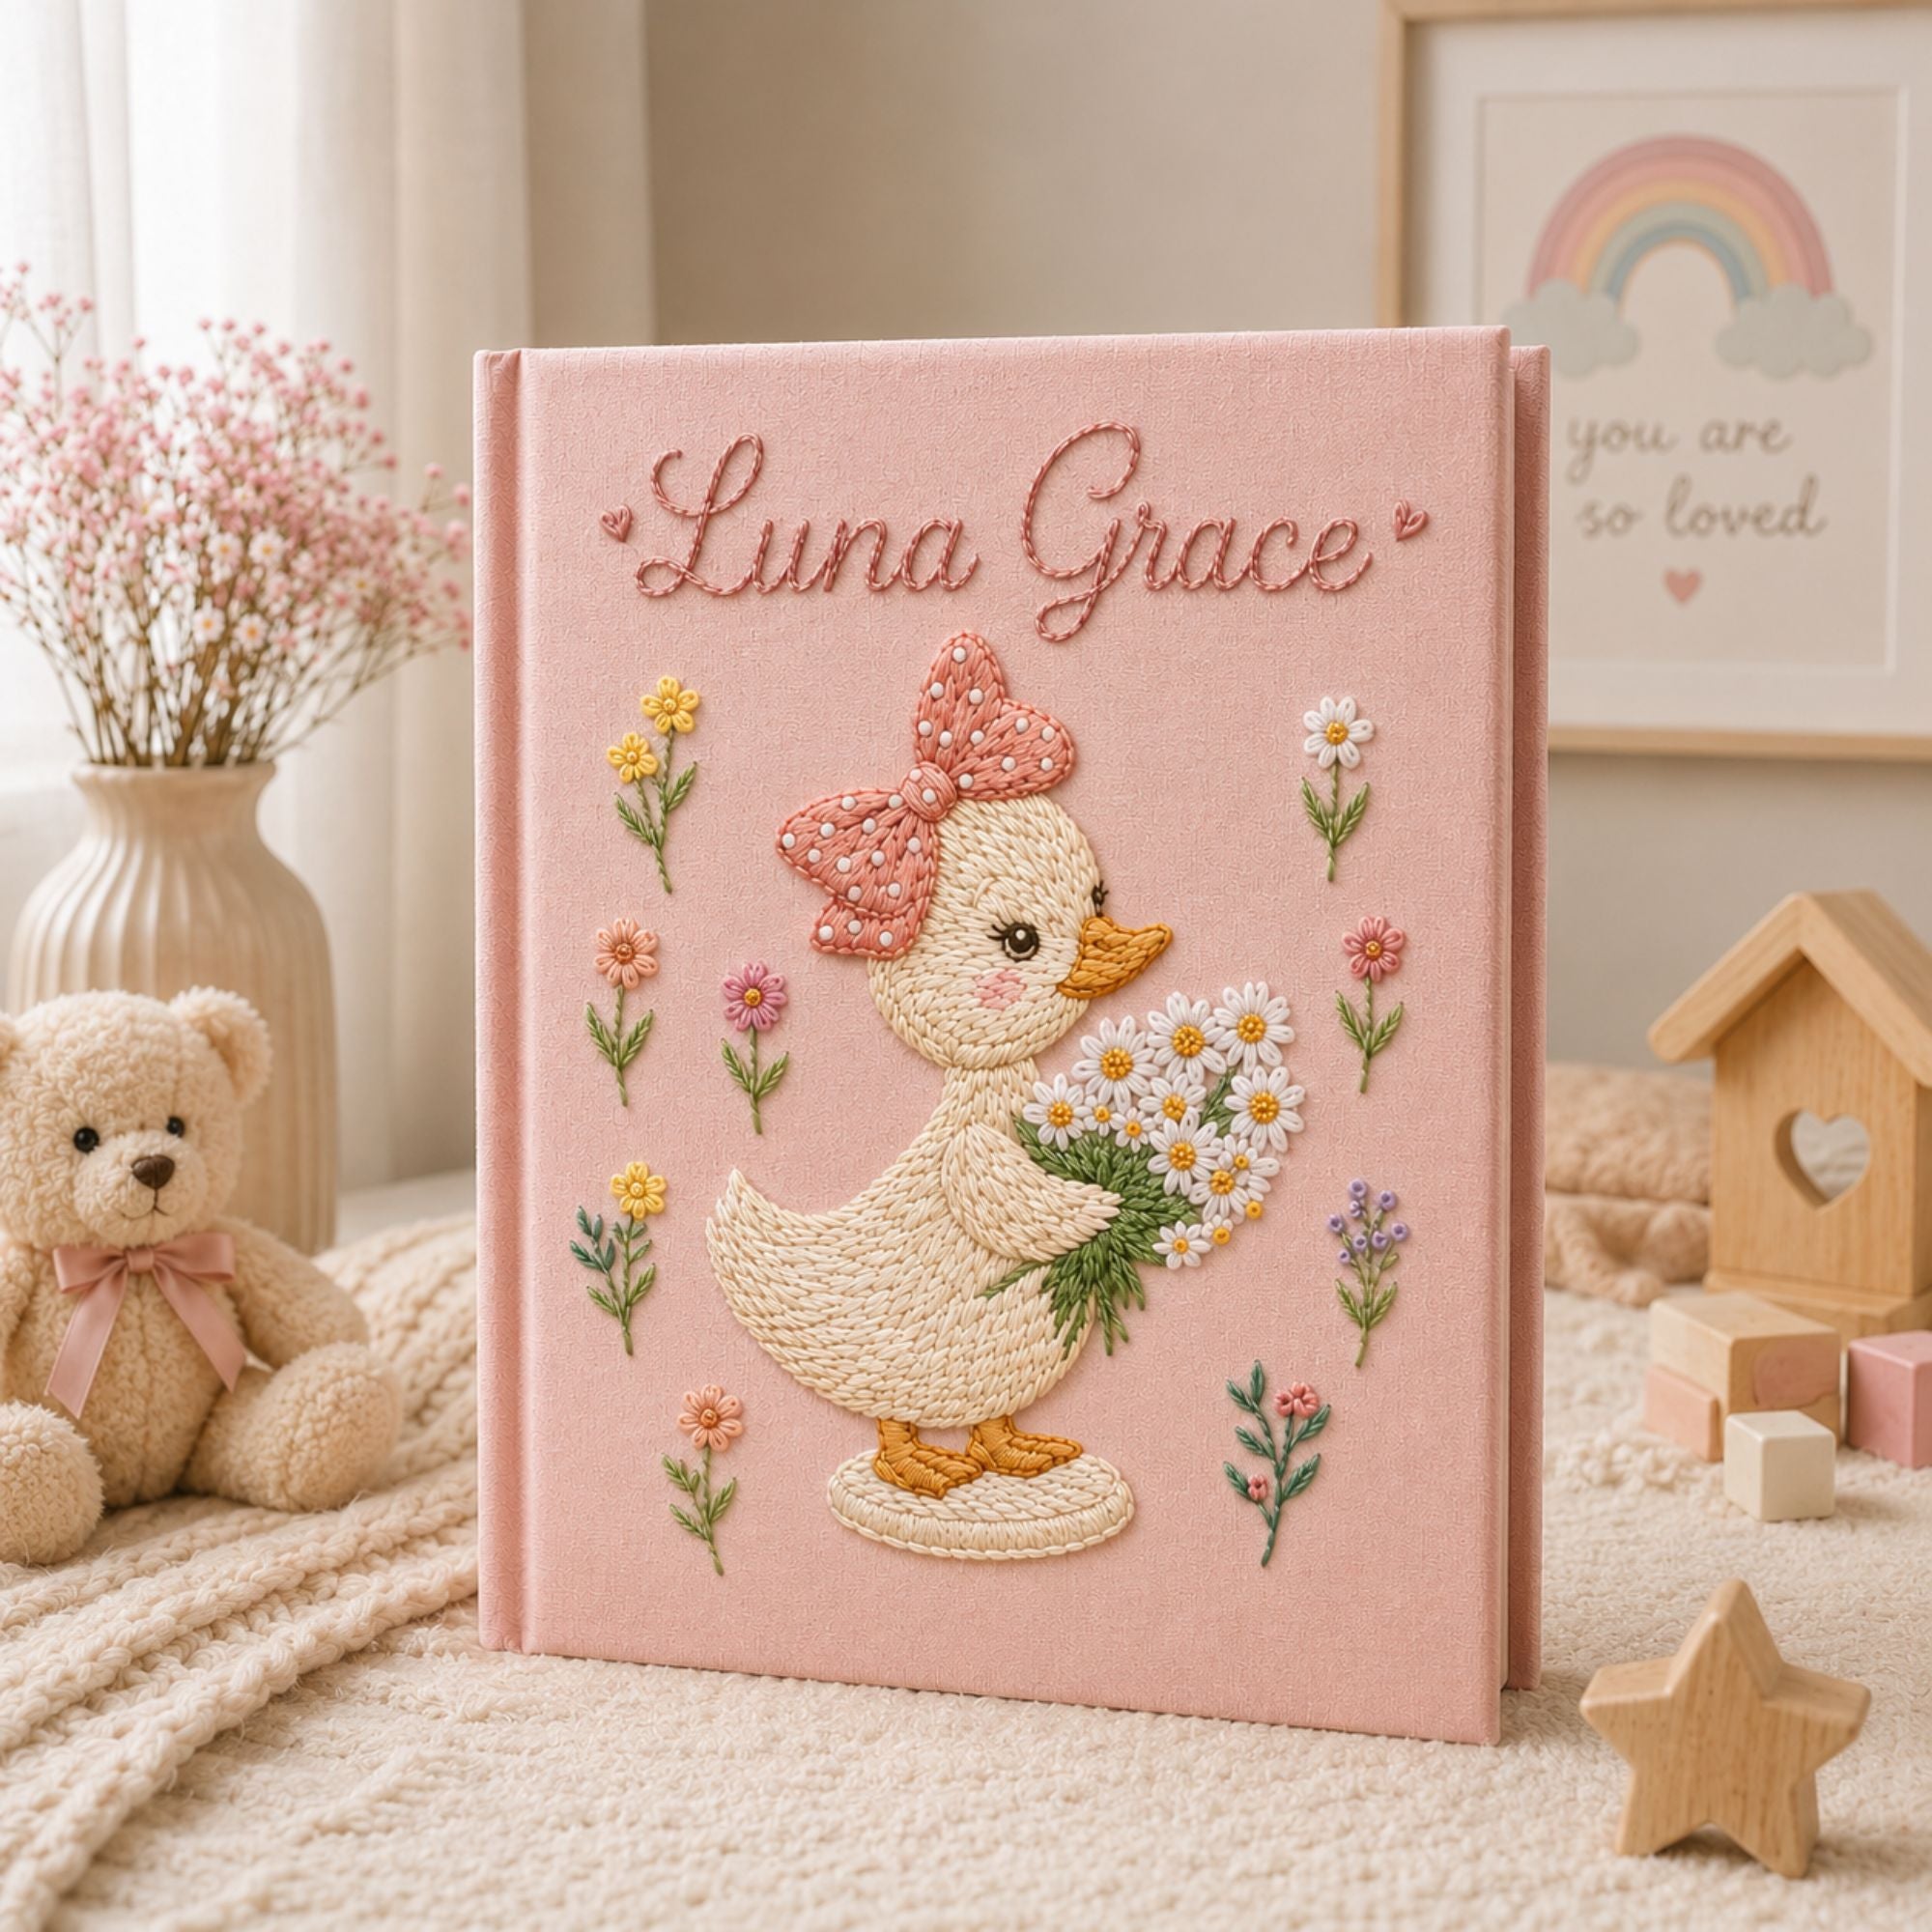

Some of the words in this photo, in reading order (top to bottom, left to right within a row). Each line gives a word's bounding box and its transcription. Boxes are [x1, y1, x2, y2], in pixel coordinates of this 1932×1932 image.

[1566, 417, 1679, 486] you
[1699, 417, 1794, 454] are
[636, 432, 980, 596] Luna
[1021, 419, 1373, 642] Grace
[1577, 499, 1643, 539] so
[1664, 472, 1829, 539] loved
